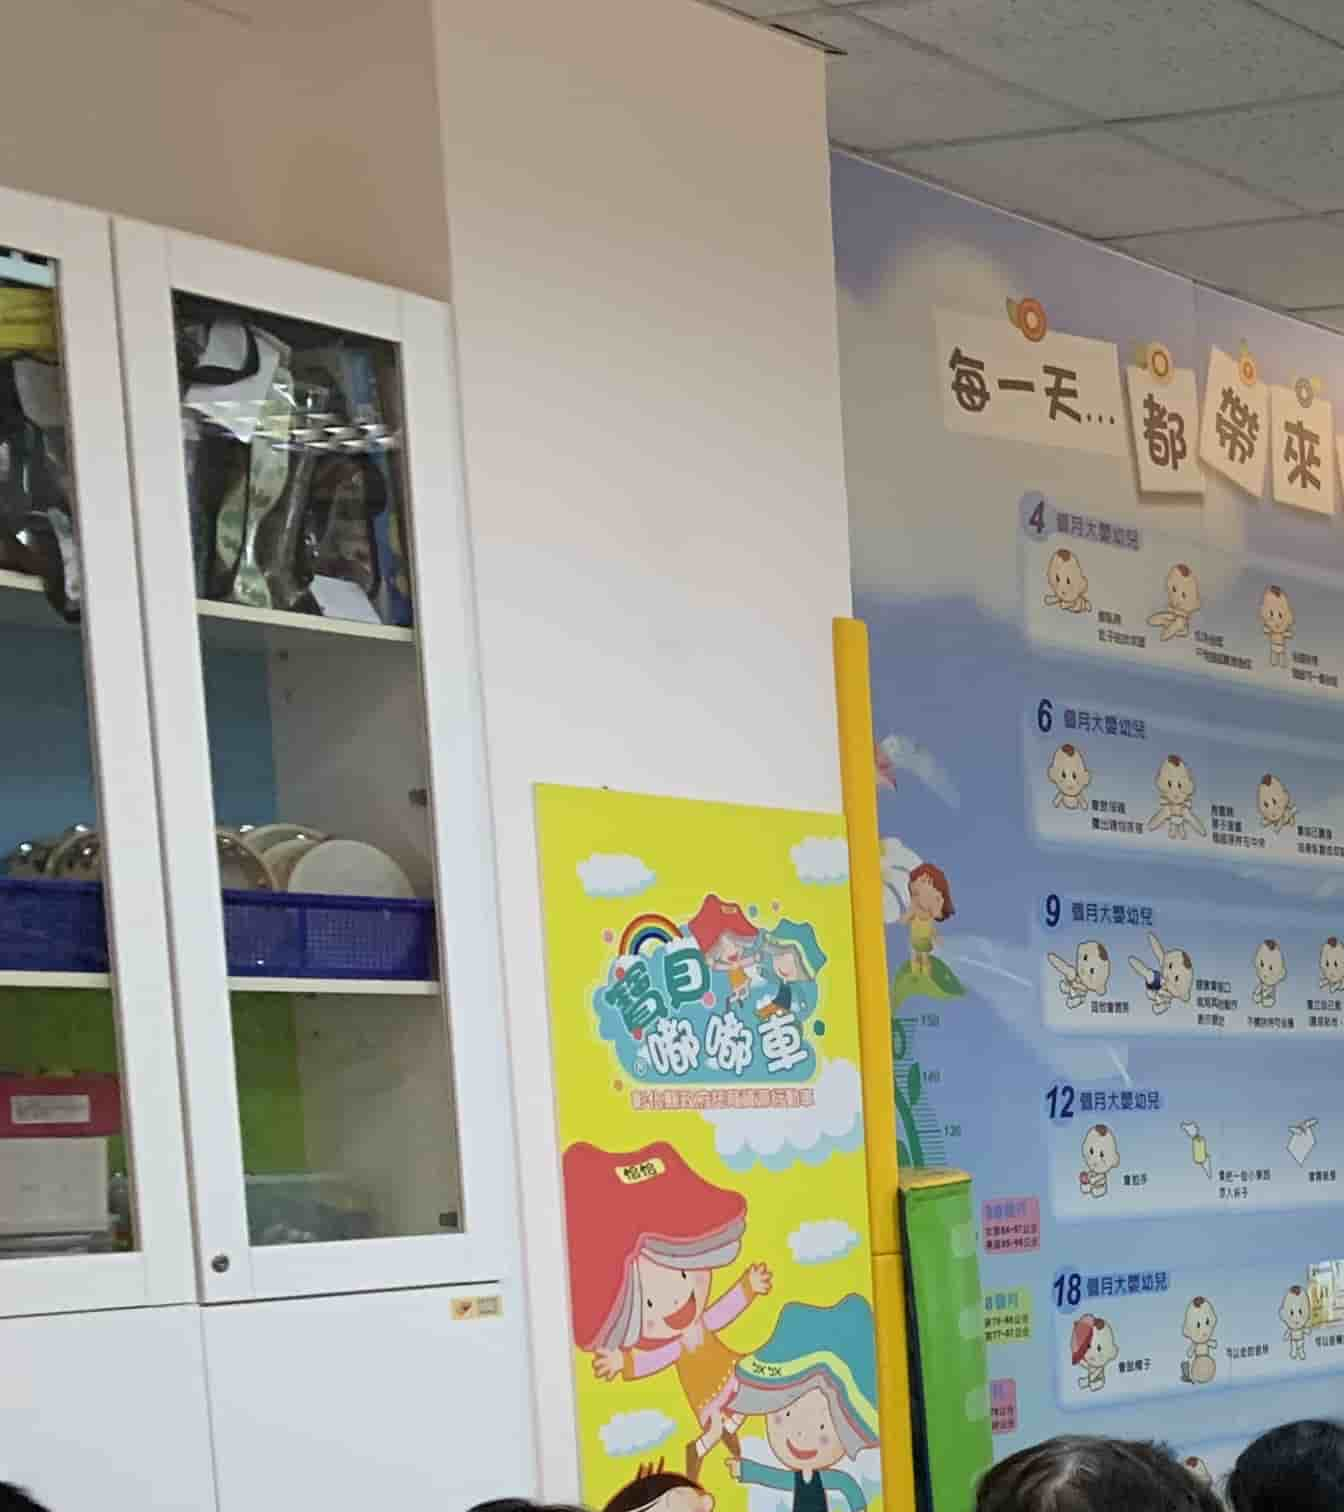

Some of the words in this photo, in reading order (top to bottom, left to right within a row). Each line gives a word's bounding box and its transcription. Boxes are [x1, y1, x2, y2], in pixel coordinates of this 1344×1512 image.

[1028, 500, 1045, 533] 4
[1037, 699, 1053, 733] 6
[1063, 708, 1147, 739] 個月大嬰幼兒
[1045, 894, 1060, 927] 9
[1071, 902, 1153, 926] 個月大嬰幼兒
[1046, 1085, 1075, 1118] 12
[1080, 1091, 1161, 1113] 個月大嬰幼兒
[1053, 1273, 1082, 1306] 18
[1086, 1271, 1168, 1297] 個月大嬰幼兒
